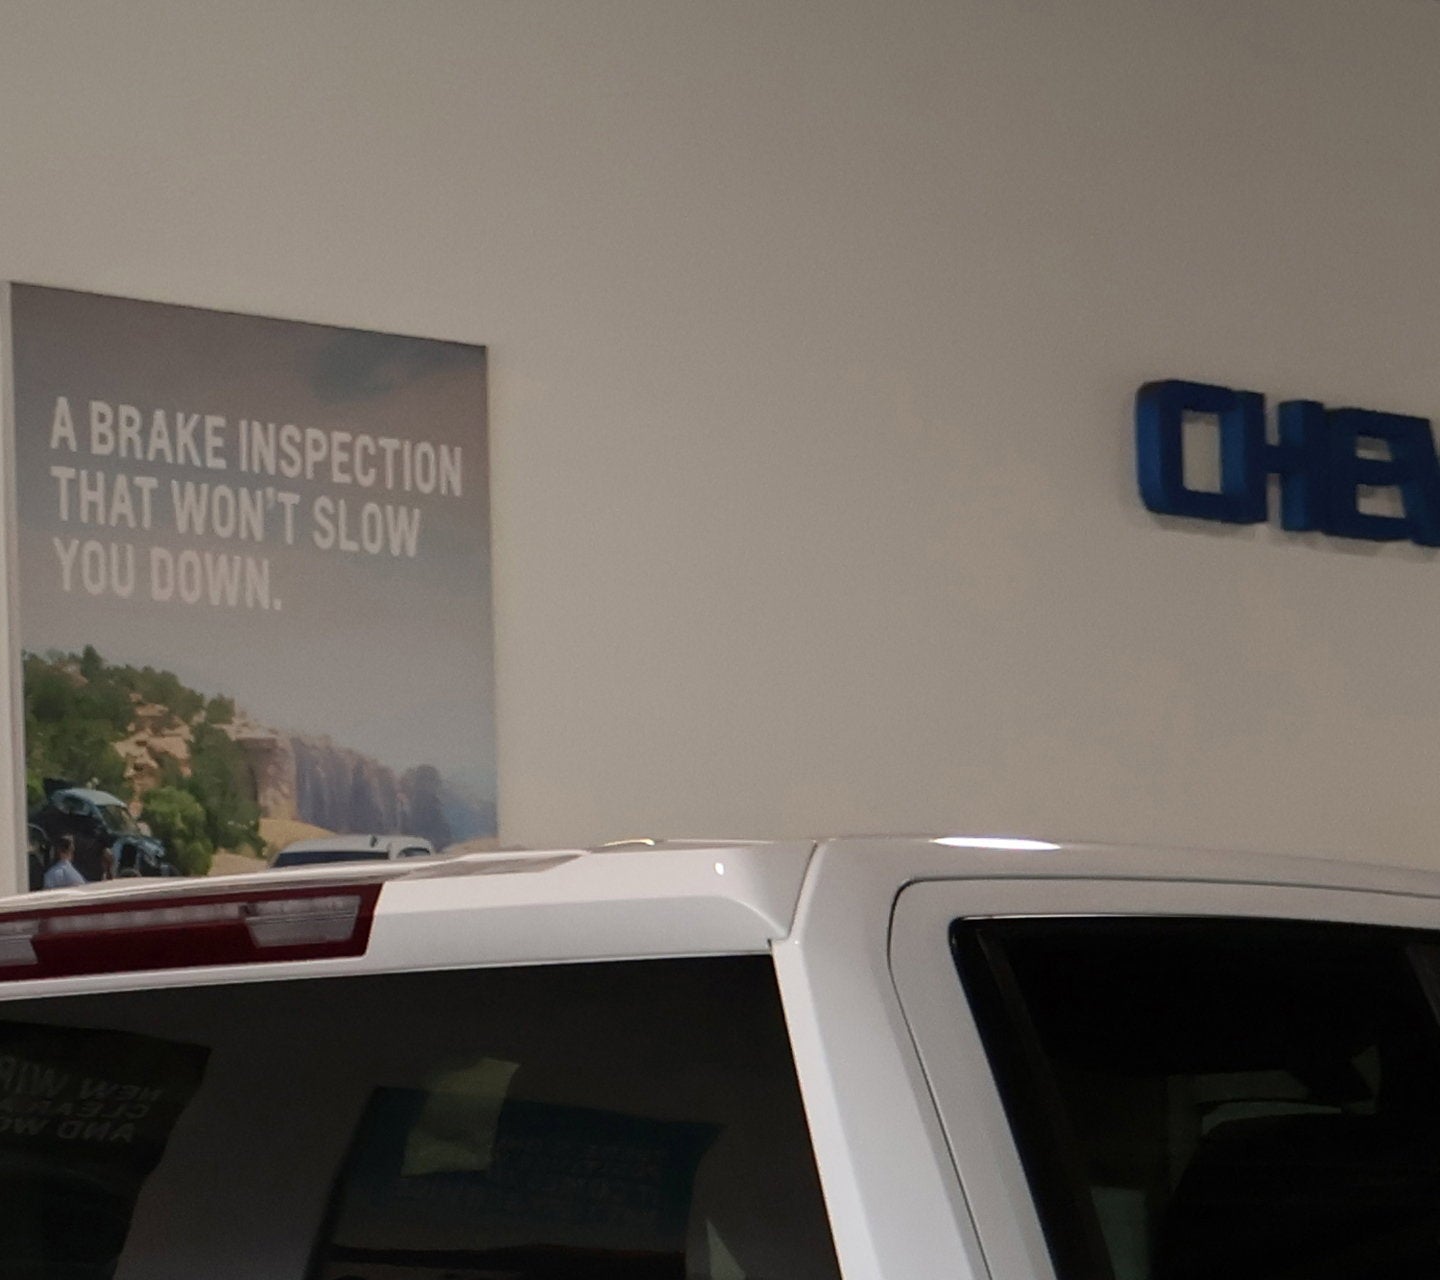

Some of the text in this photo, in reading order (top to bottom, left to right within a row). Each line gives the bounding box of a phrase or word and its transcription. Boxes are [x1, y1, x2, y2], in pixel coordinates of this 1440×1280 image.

[51, 396, 464, 497] A BRAKE INSPECTION
[51, 465, 421, 559] THAT WON'T SLOW
[52, 537, 283, 611] YOU DOWN.
